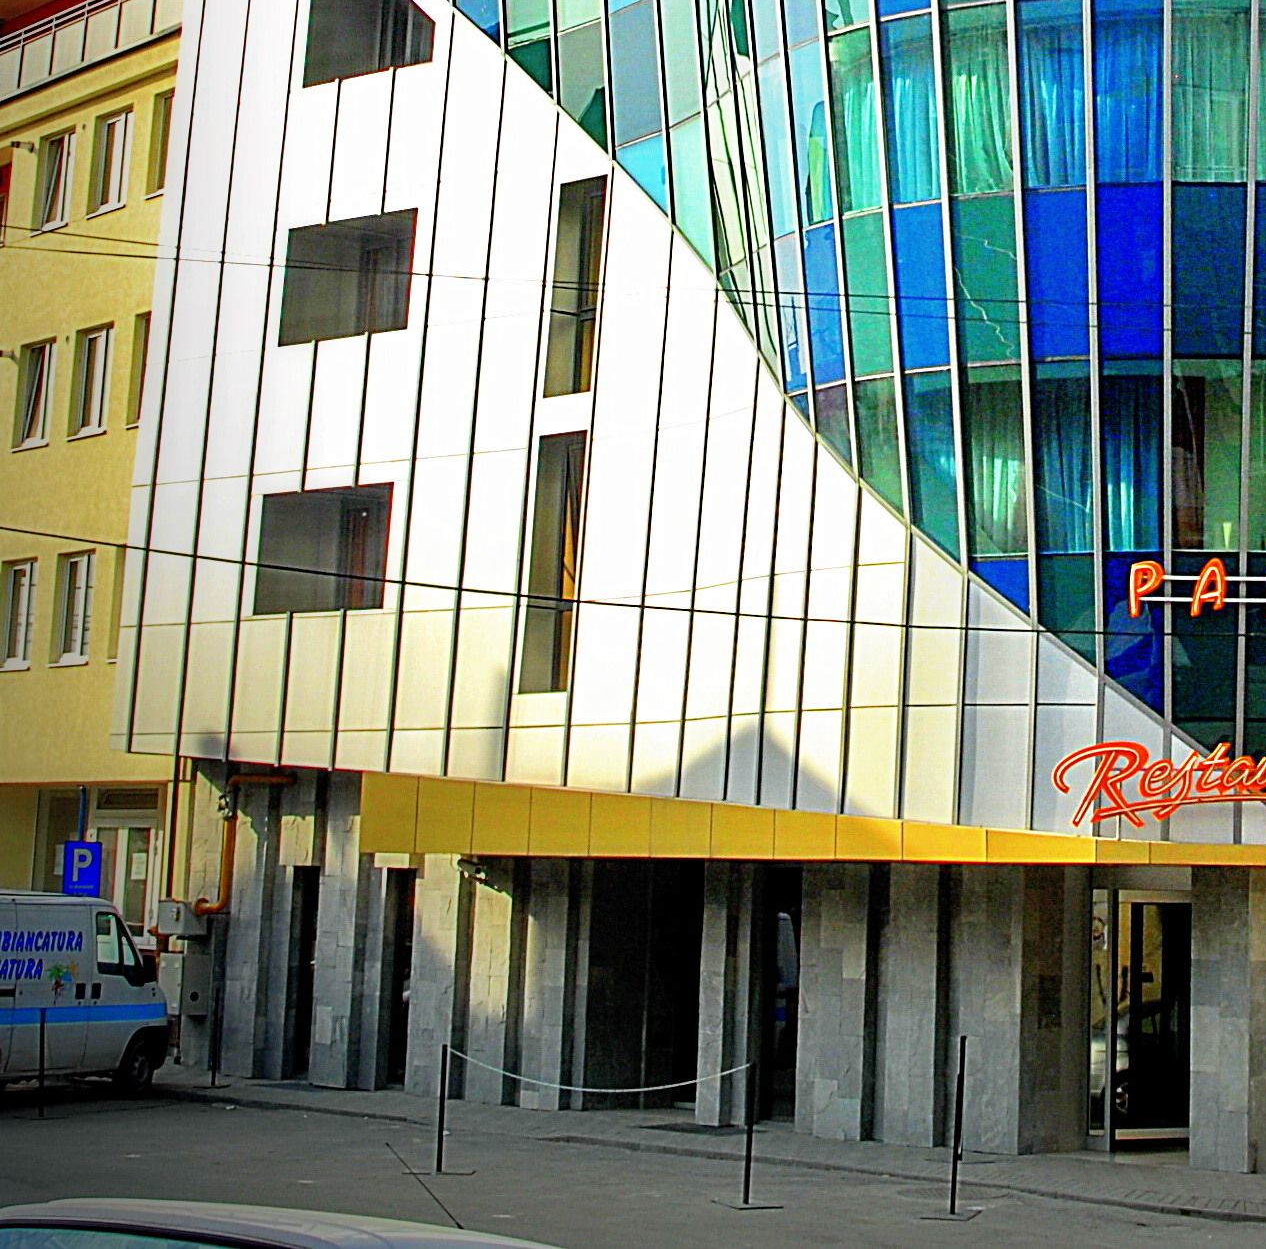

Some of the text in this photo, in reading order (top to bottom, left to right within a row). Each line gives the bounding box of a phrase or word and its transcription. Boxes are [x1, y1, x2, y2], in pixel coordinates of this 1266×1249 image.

[72, 848, 93, 882] P
[0, 931, 83, 952] BIANCATURA
[0, 958, 43, 980] ATURA
